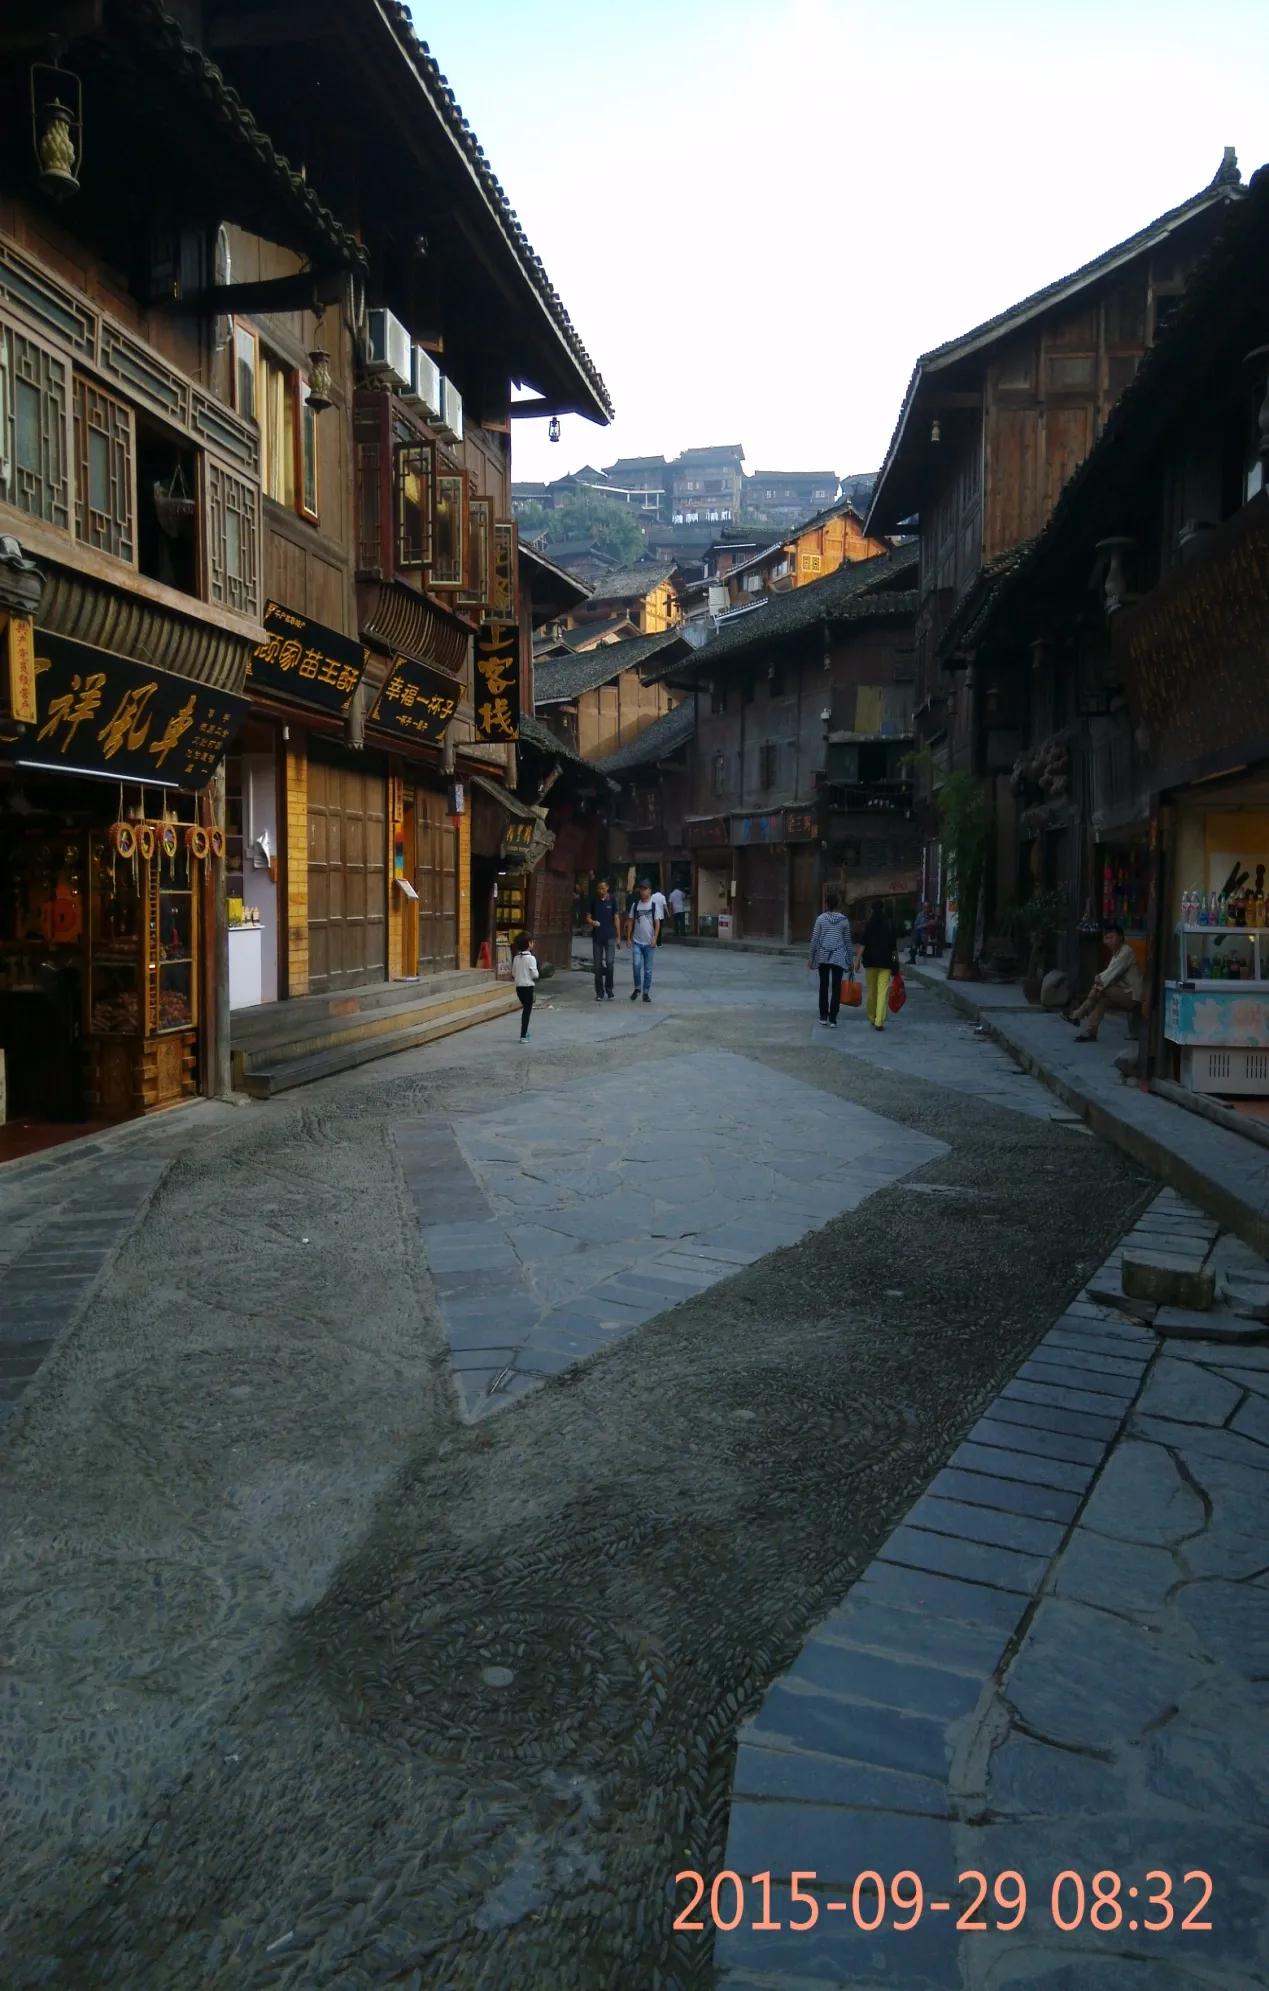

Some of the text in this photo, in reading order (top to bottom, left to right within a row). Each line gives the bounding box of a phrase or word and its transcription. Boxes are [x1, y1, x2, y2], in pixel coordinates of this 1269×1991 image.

[386, 676, 454, 719] 幸福一杯子
